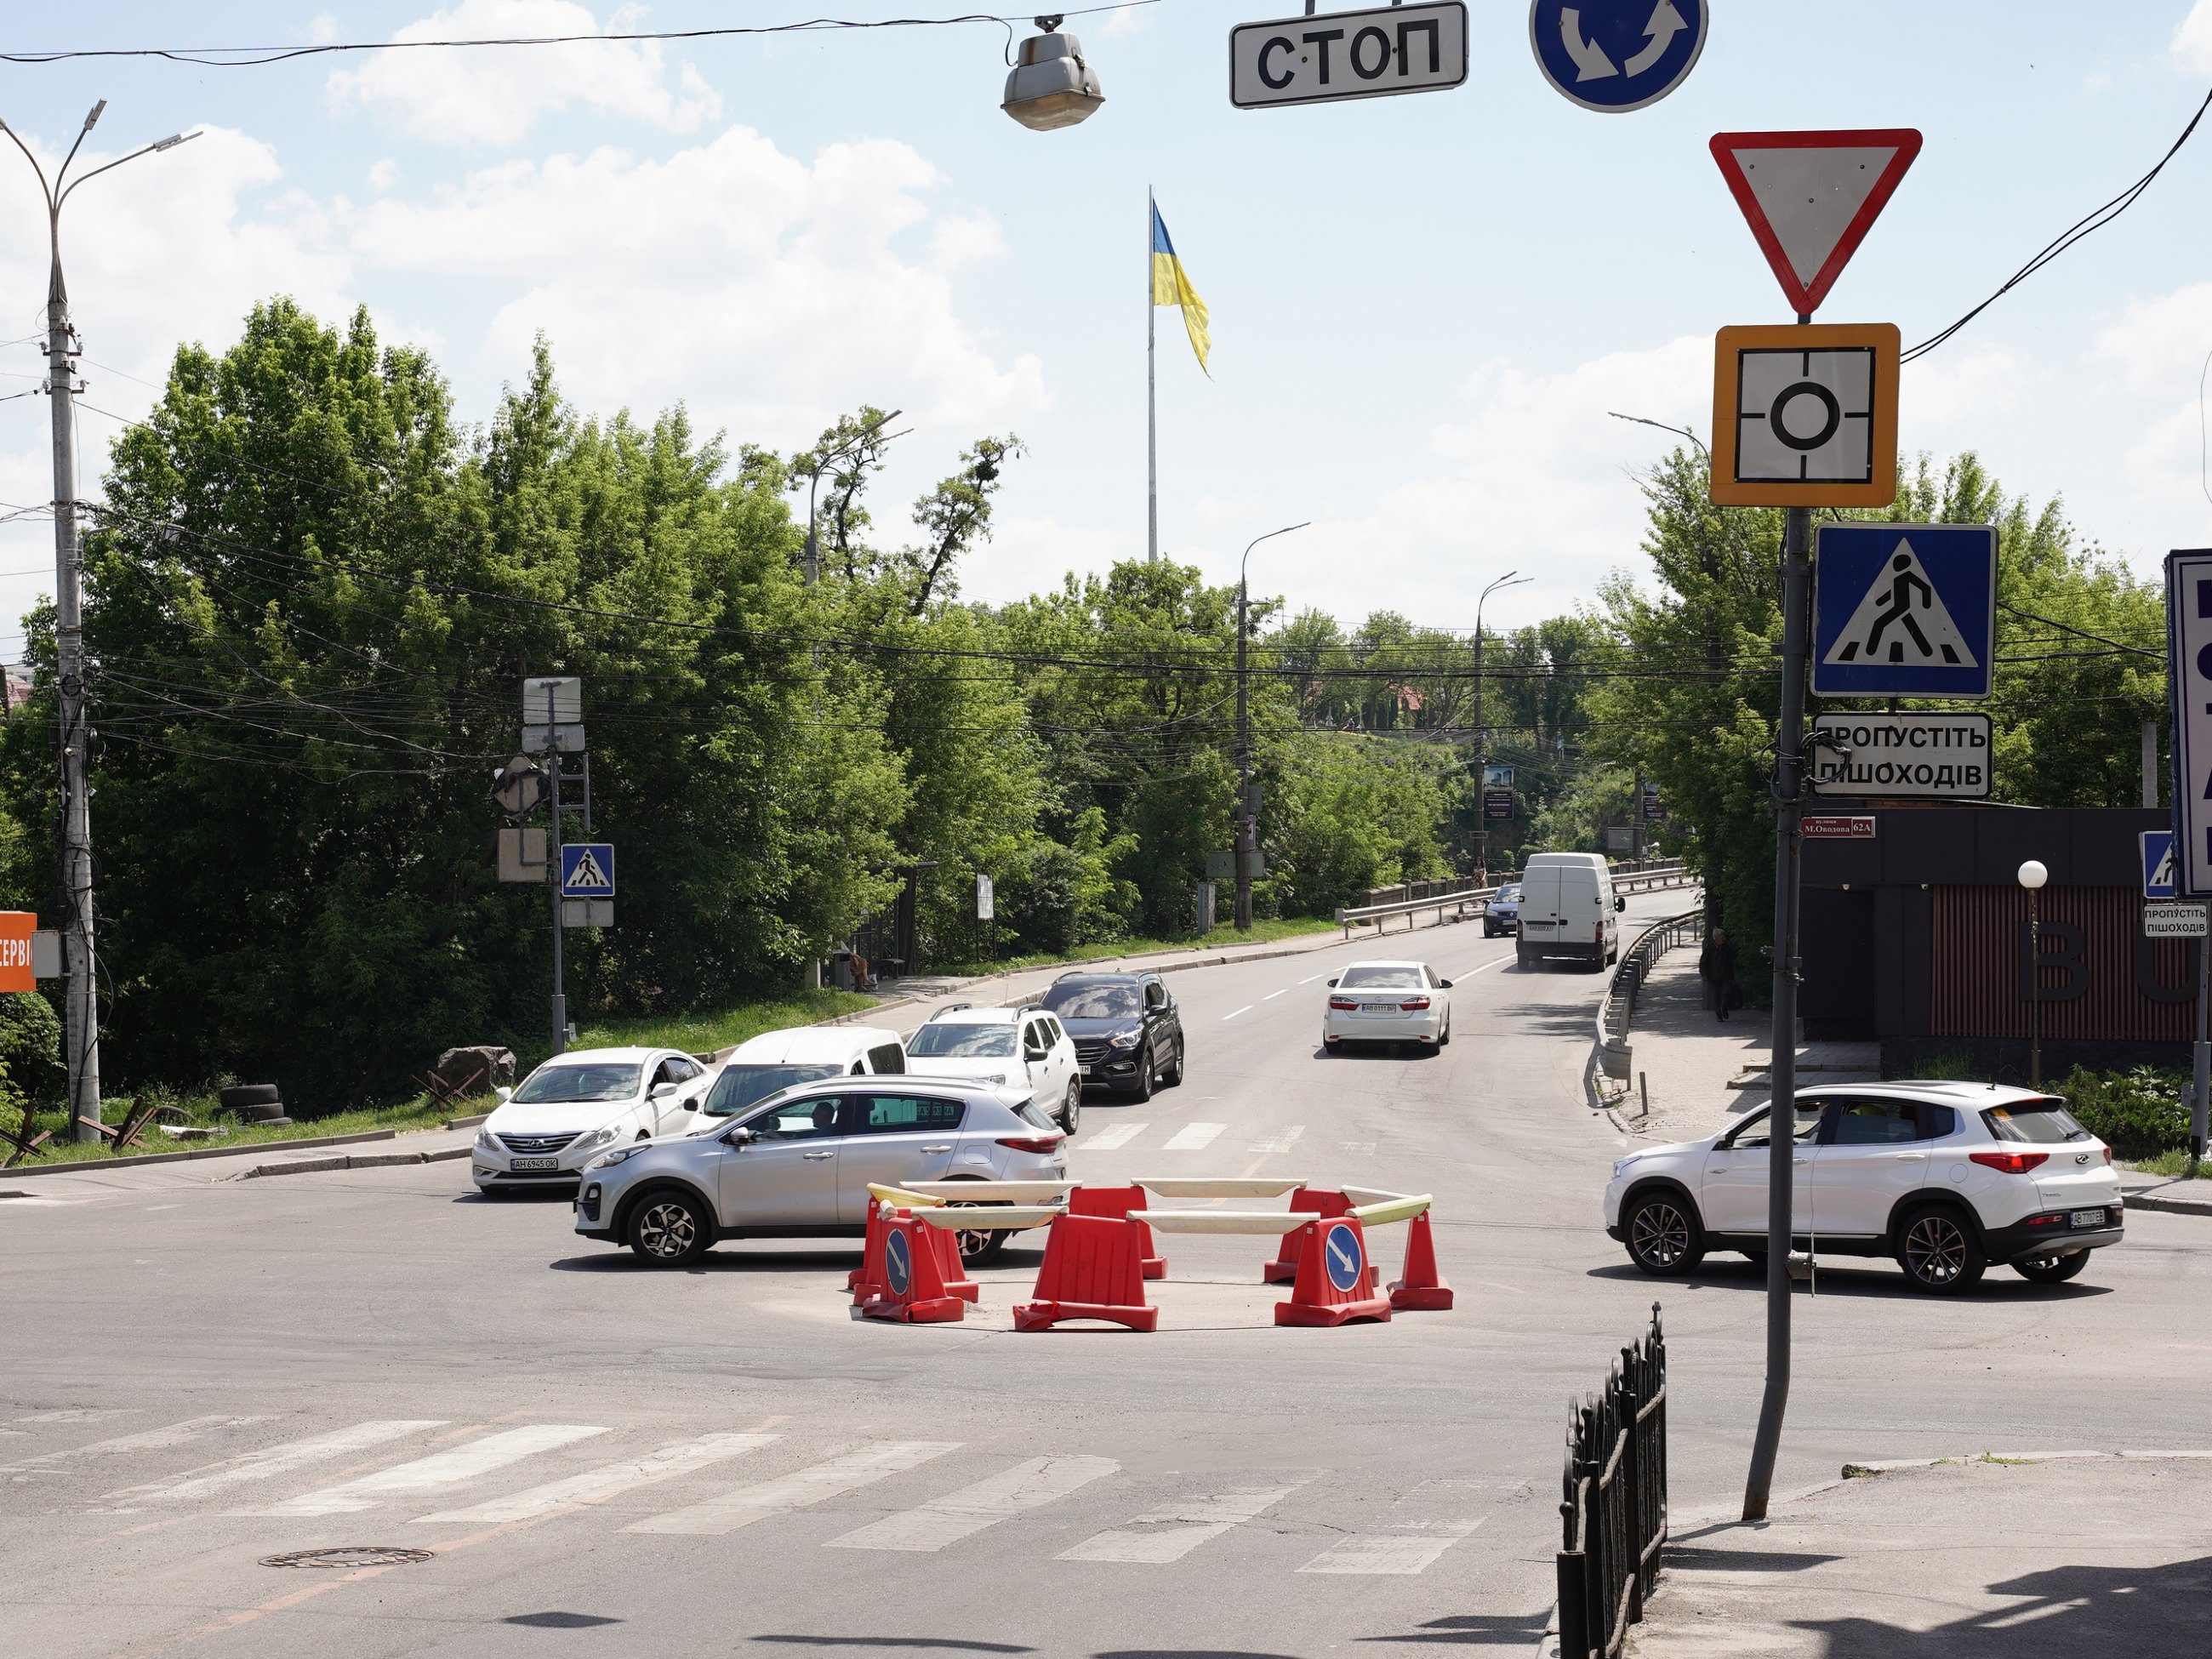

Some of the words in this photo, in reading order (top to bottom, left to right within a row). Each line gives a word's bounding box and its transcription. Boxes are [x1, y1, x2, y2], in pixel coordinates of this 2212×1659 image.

[1257, 19, 1440, 89] СТОП
[1821, 762, 1982, 789] ПІШОХОДІВ
[2145, 909, 2206, 918] ПРОПУСТІТЬ
[2147, 923, 2205, 933] ПІШОХОДІВ
[0, 939, 32, 966] ЕРВІ
[527, 1160, 544, 1168] 6945
[545, 1160, 556, 1168] OK
